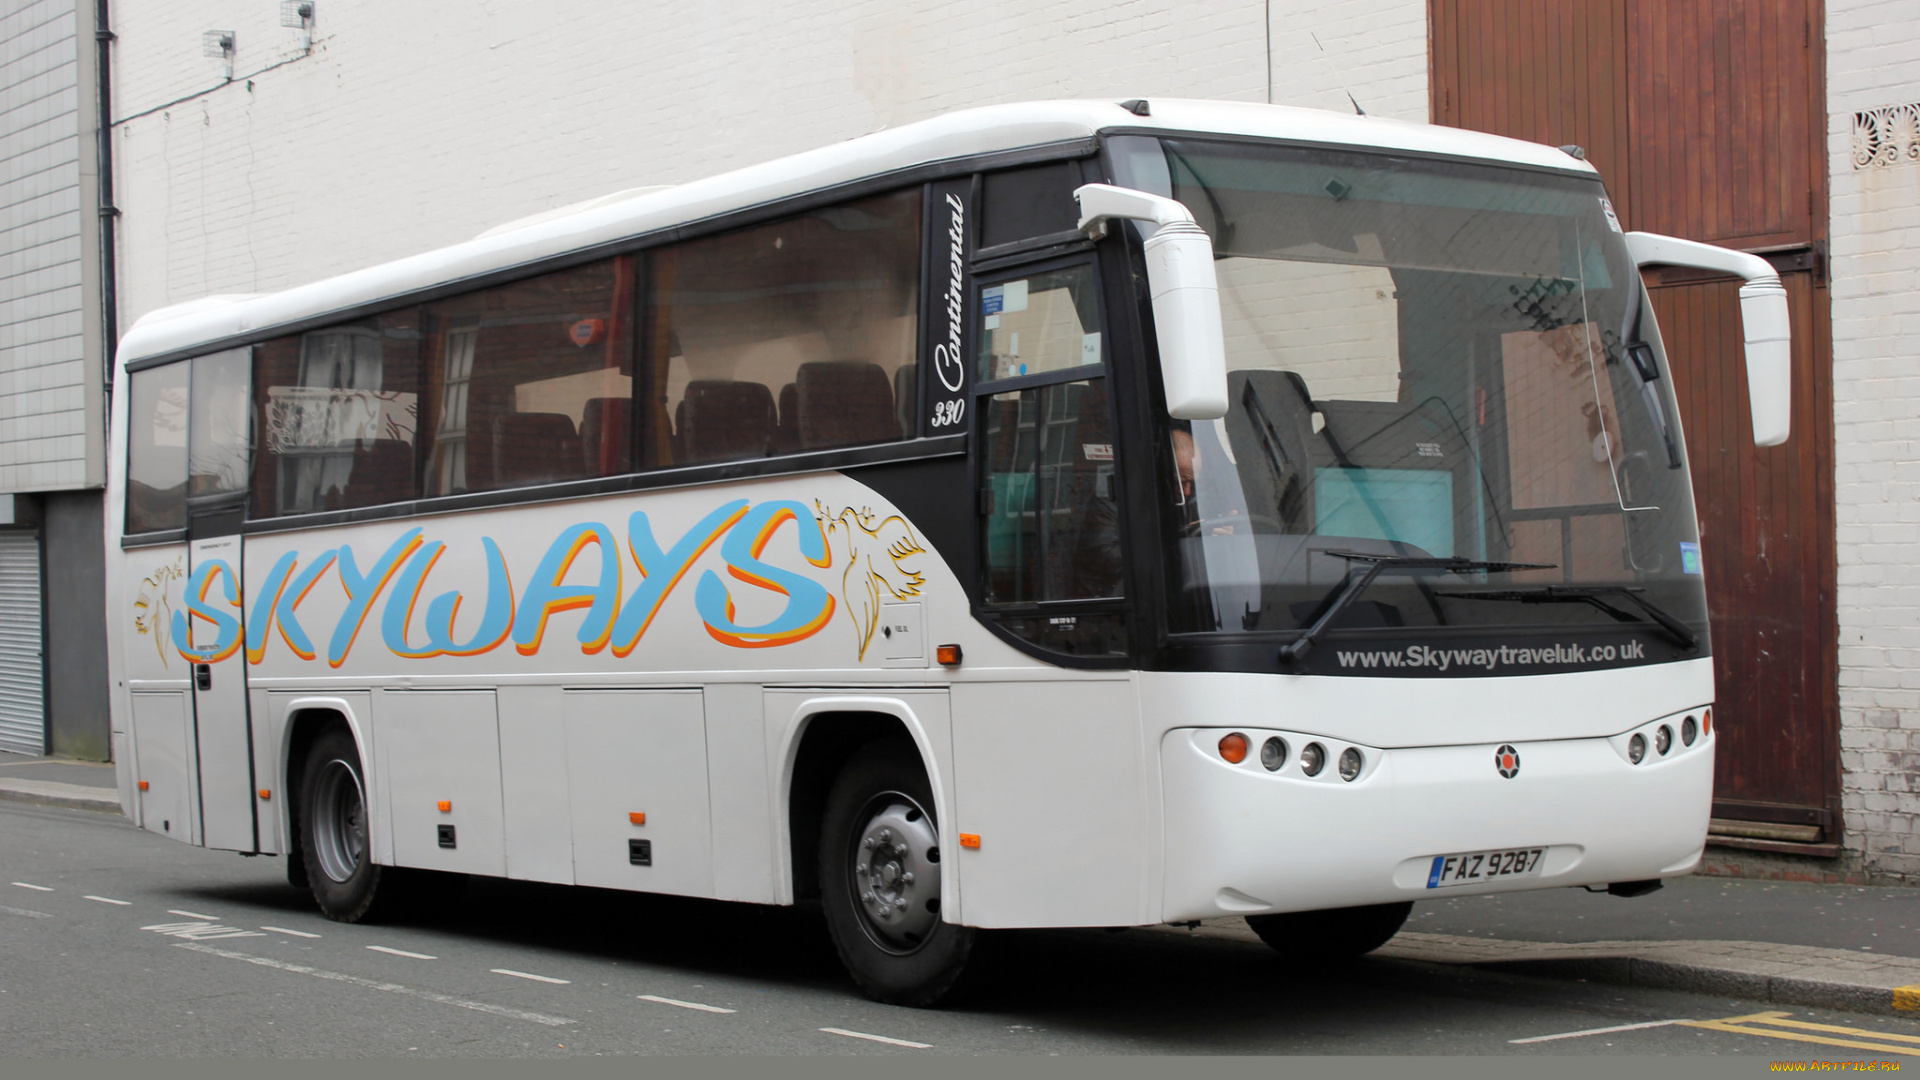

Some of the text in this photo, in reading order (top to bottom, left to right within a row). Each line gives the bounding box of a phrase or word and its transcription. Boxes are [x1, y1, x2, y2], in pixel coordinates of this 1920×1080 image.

[934, 193, 964, 392] Continental
[931, 398, 965, 428] 330
[171, 498, 836, 669] SKYWAYS
[1336, 639, 1645, 671] www.Skywaytraveluk.co uk
[1440, 849, 1543, 881] FAZ 9287
